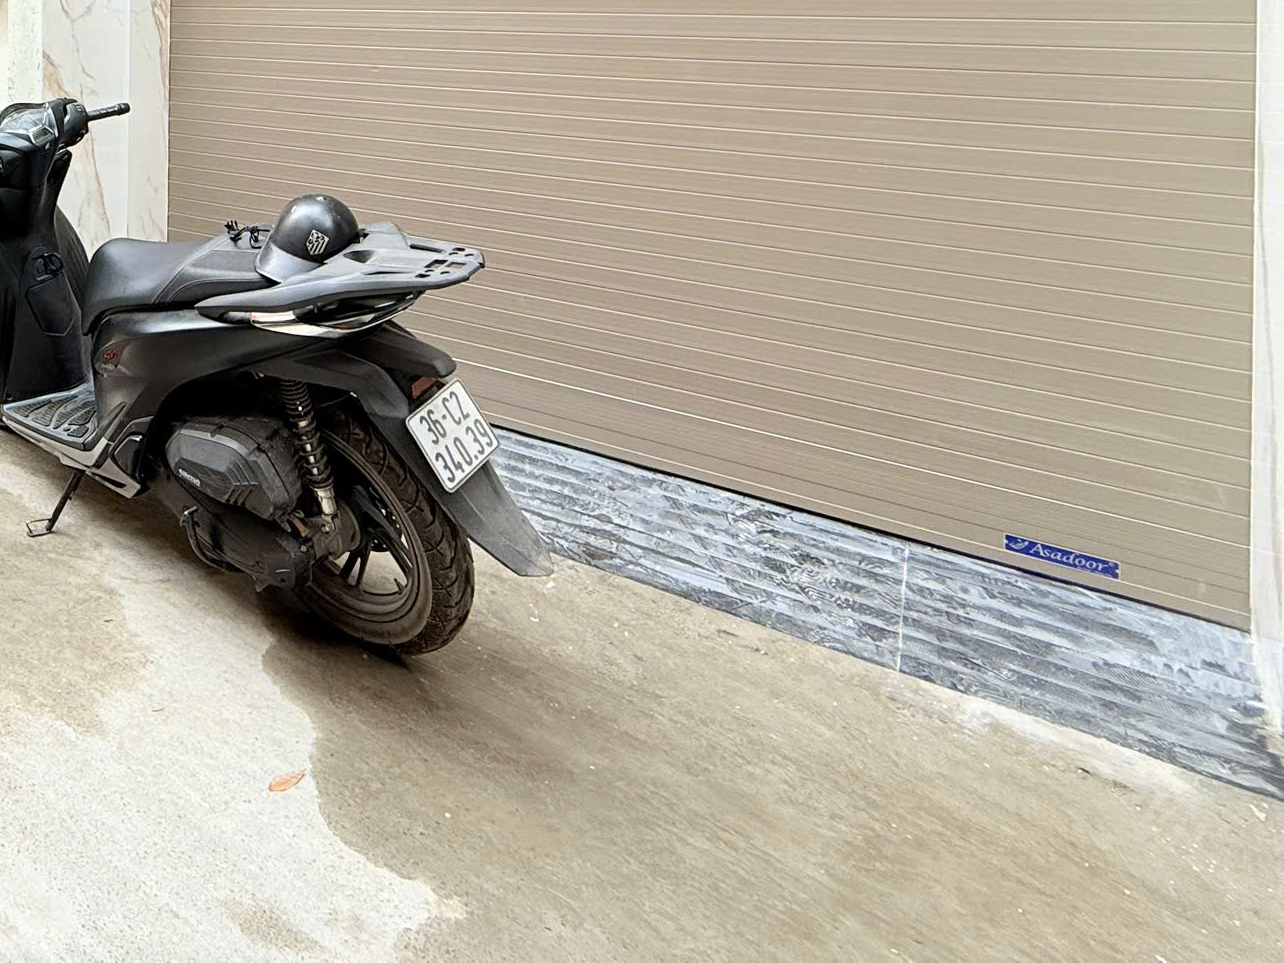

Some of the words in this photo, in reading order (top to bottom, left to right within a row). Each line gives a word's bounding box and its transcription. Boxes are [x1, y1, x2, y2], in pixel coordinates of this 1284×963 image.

[419, 391, 470, 445] 36-C2
[435, 418, 493, 483] 340.39
[1029, 543, 1108, 572] Asadoor
